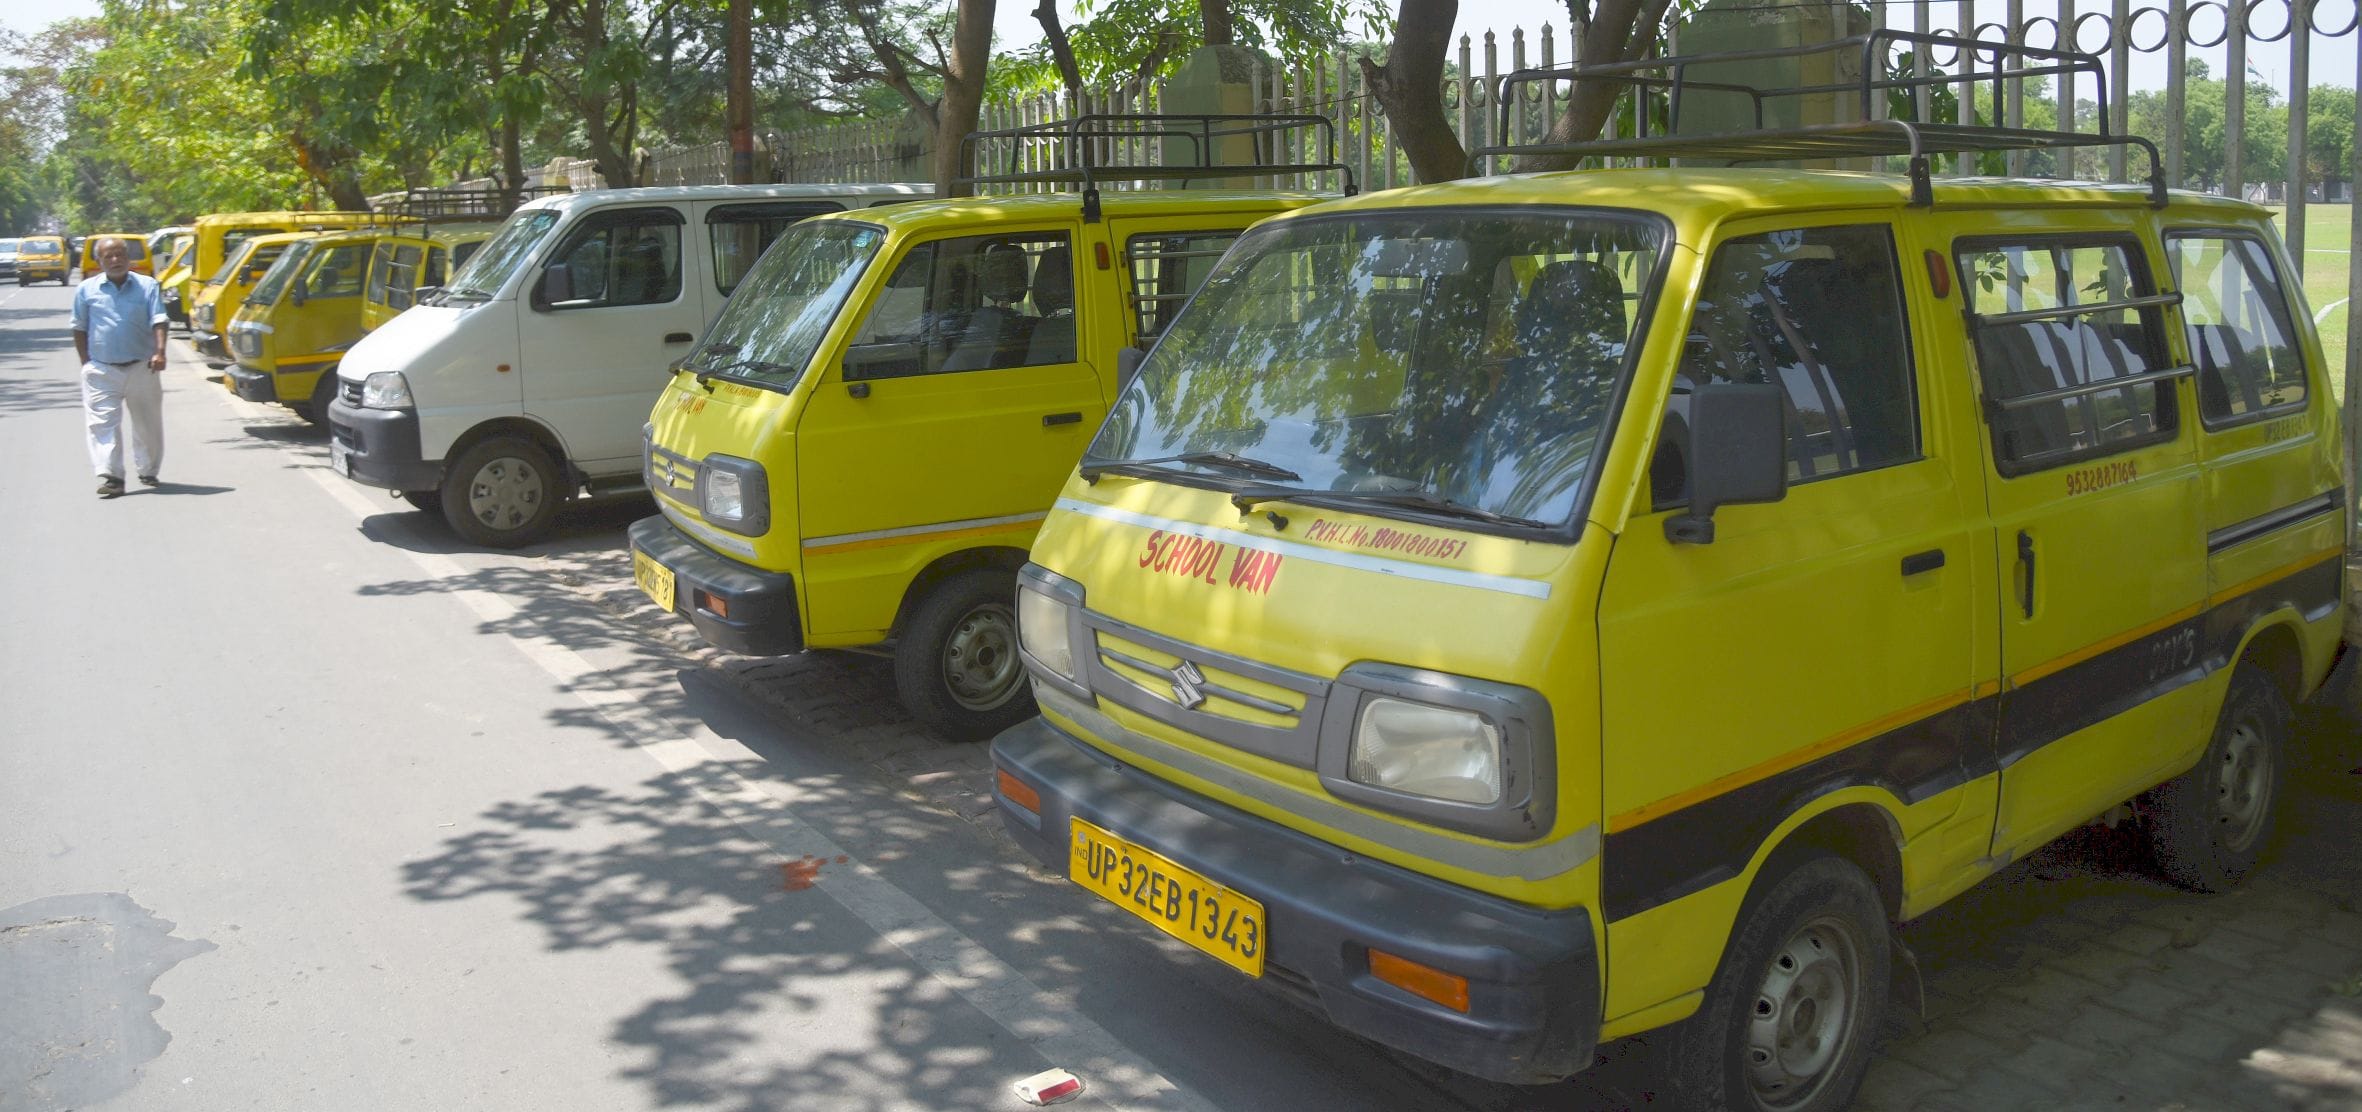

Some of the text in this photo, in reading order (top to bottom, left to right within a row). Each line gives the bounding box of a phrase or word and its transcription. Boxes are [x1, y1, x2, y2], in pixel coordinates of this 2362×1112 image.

[1139, 529, 1283, 597] SCHOOL VAN
[1074, 846, 1088, 861] IND
[1087, 837, 1257, 958] UP32EB1343
